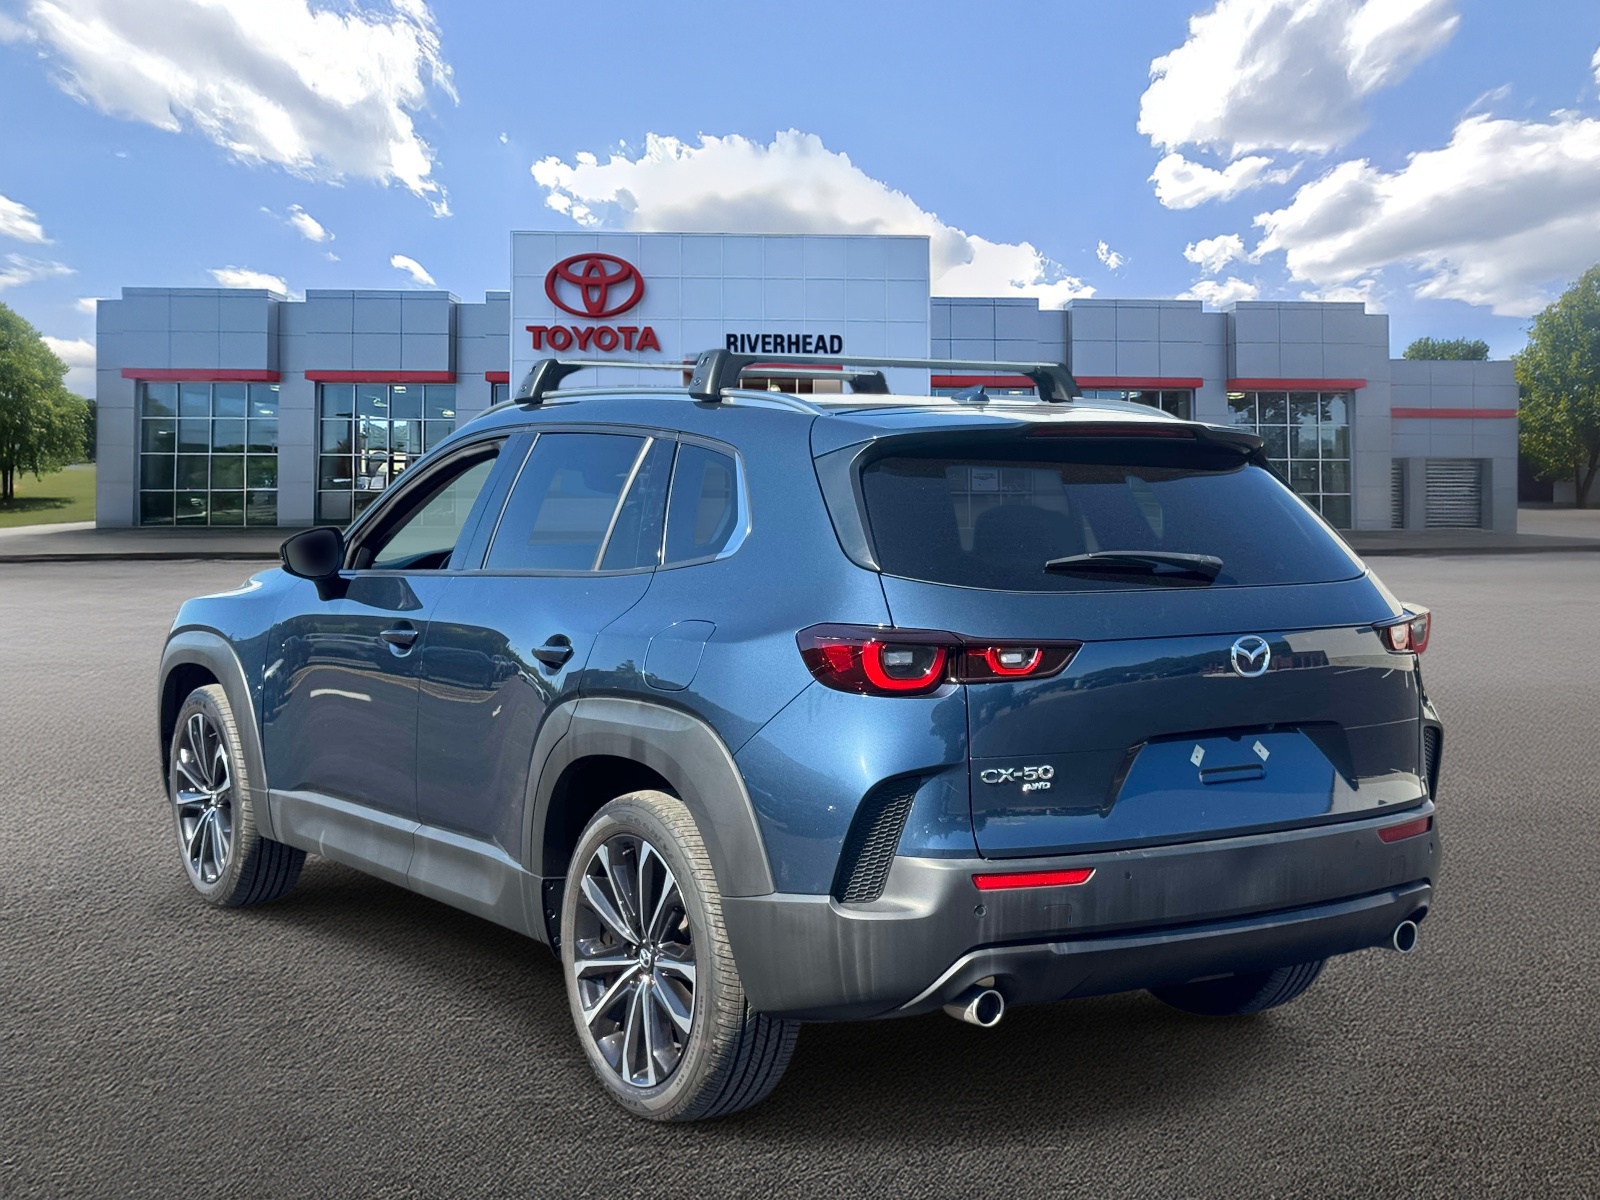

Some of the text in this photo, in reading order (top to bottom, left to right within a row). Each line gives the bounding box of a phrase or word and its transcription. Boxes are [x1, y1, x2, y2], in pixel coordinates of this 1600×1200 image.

[525, 325, 661, 351] TOYOTA
[726, 333, 843, 354] RIVERHEAD
[980, 765, 1055, 784] CX-50
[1022, 781, 1051, 792] AWD
